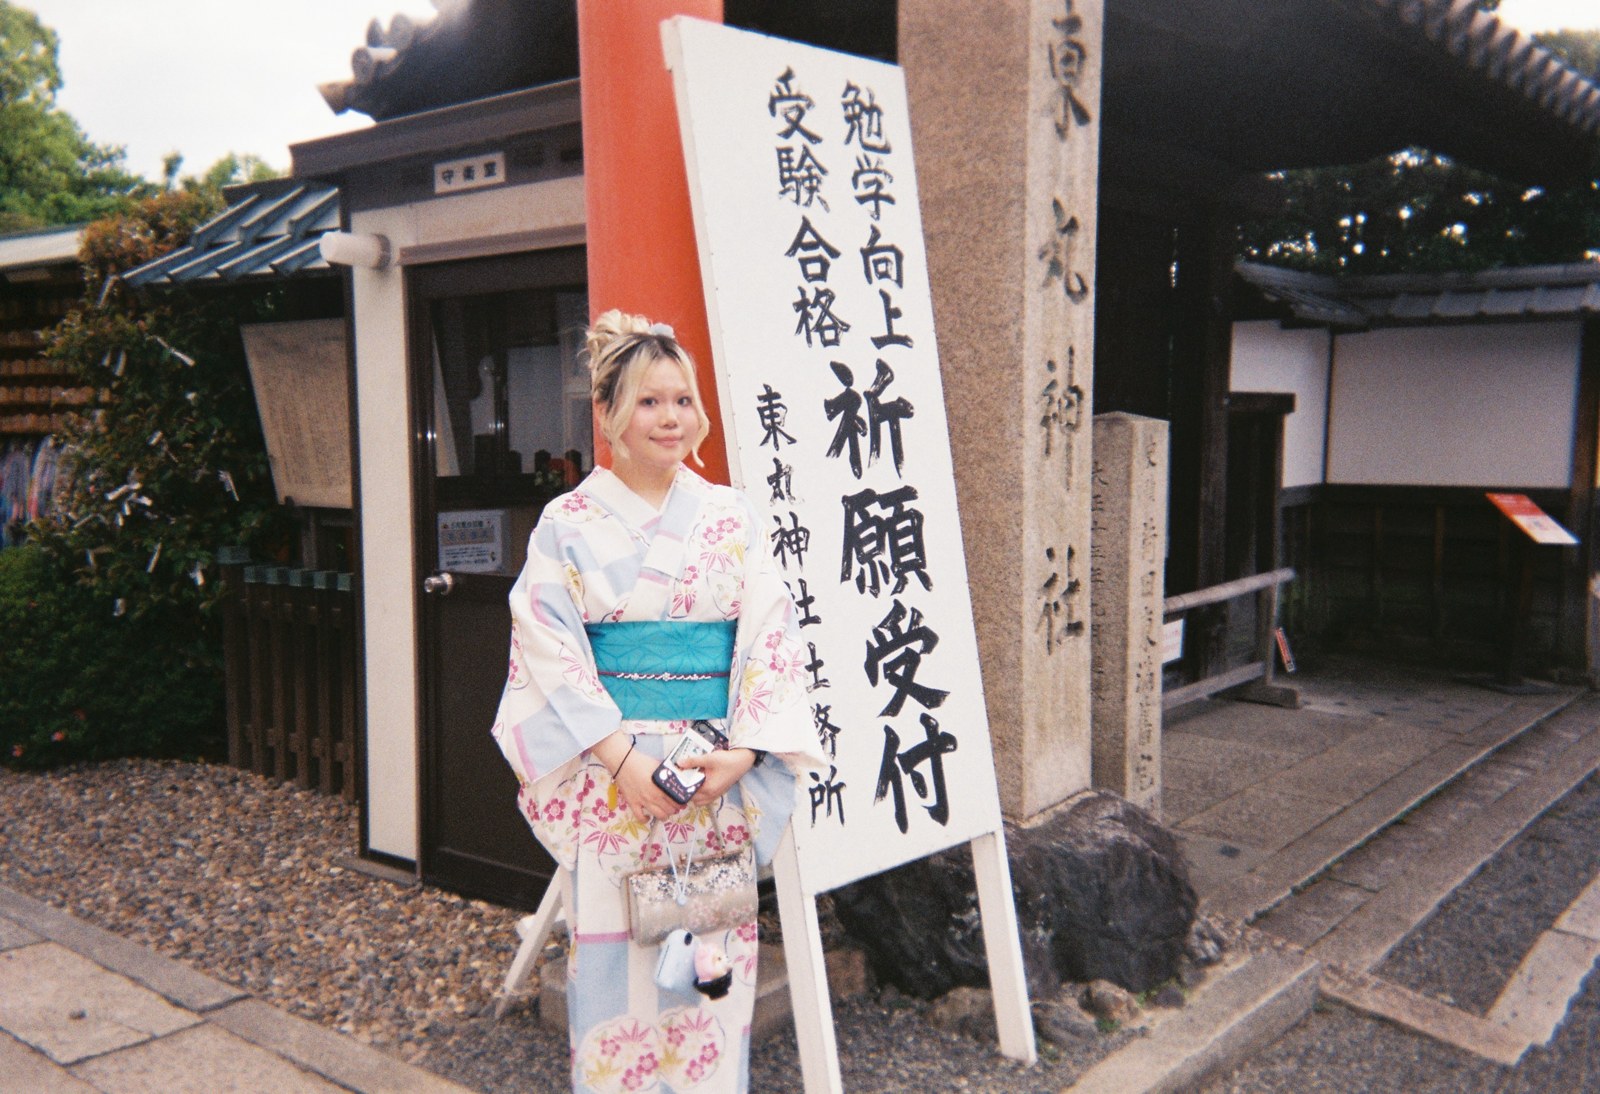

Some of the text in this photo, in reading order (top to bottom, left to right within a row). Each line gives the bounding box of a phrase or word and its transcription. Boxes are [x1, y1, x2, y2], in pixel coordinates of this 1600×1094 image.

[767, 66, 851, 349] 受験合格
[841, 80, 914, 350] 勉学向上
[822, 357, 958, 834] 祈願受付
